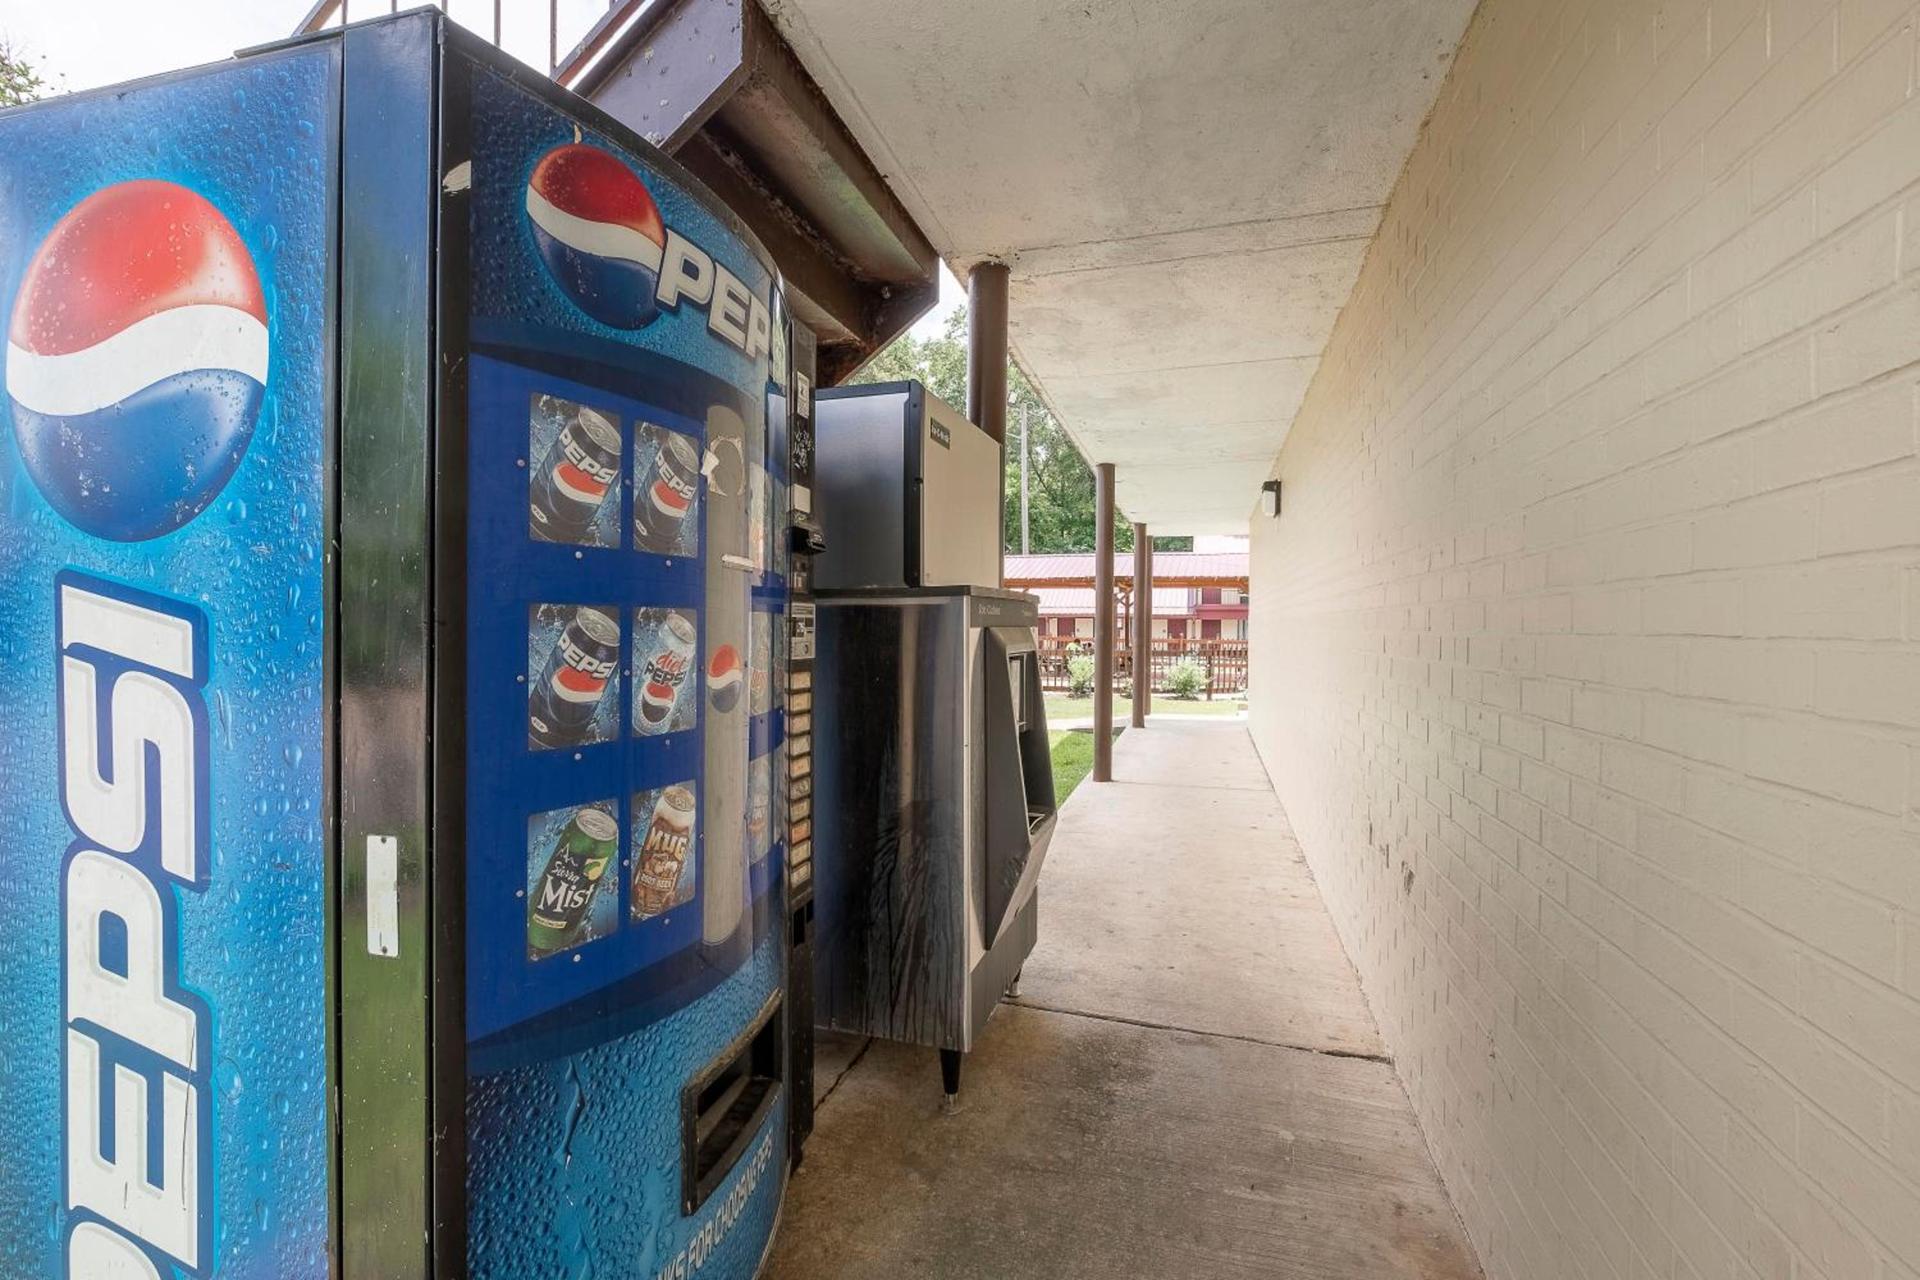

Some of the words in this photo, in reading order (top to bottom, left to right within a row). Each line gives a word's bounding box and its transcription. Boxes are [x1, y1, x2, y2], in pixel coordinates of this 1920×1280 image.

[559, 426, 618, 484] PEPSI
[557, 632, 618, 679] PEPSI
[655, 650, 687, 673] diet
[649, 826, 689, 861] MUG
[551, 860, 580, 883] Sierra
[536, 874, 595, 912] Mist
[62, 584, 198, 1280] EPSI
[687, 1219, 714, 1280] FOR
